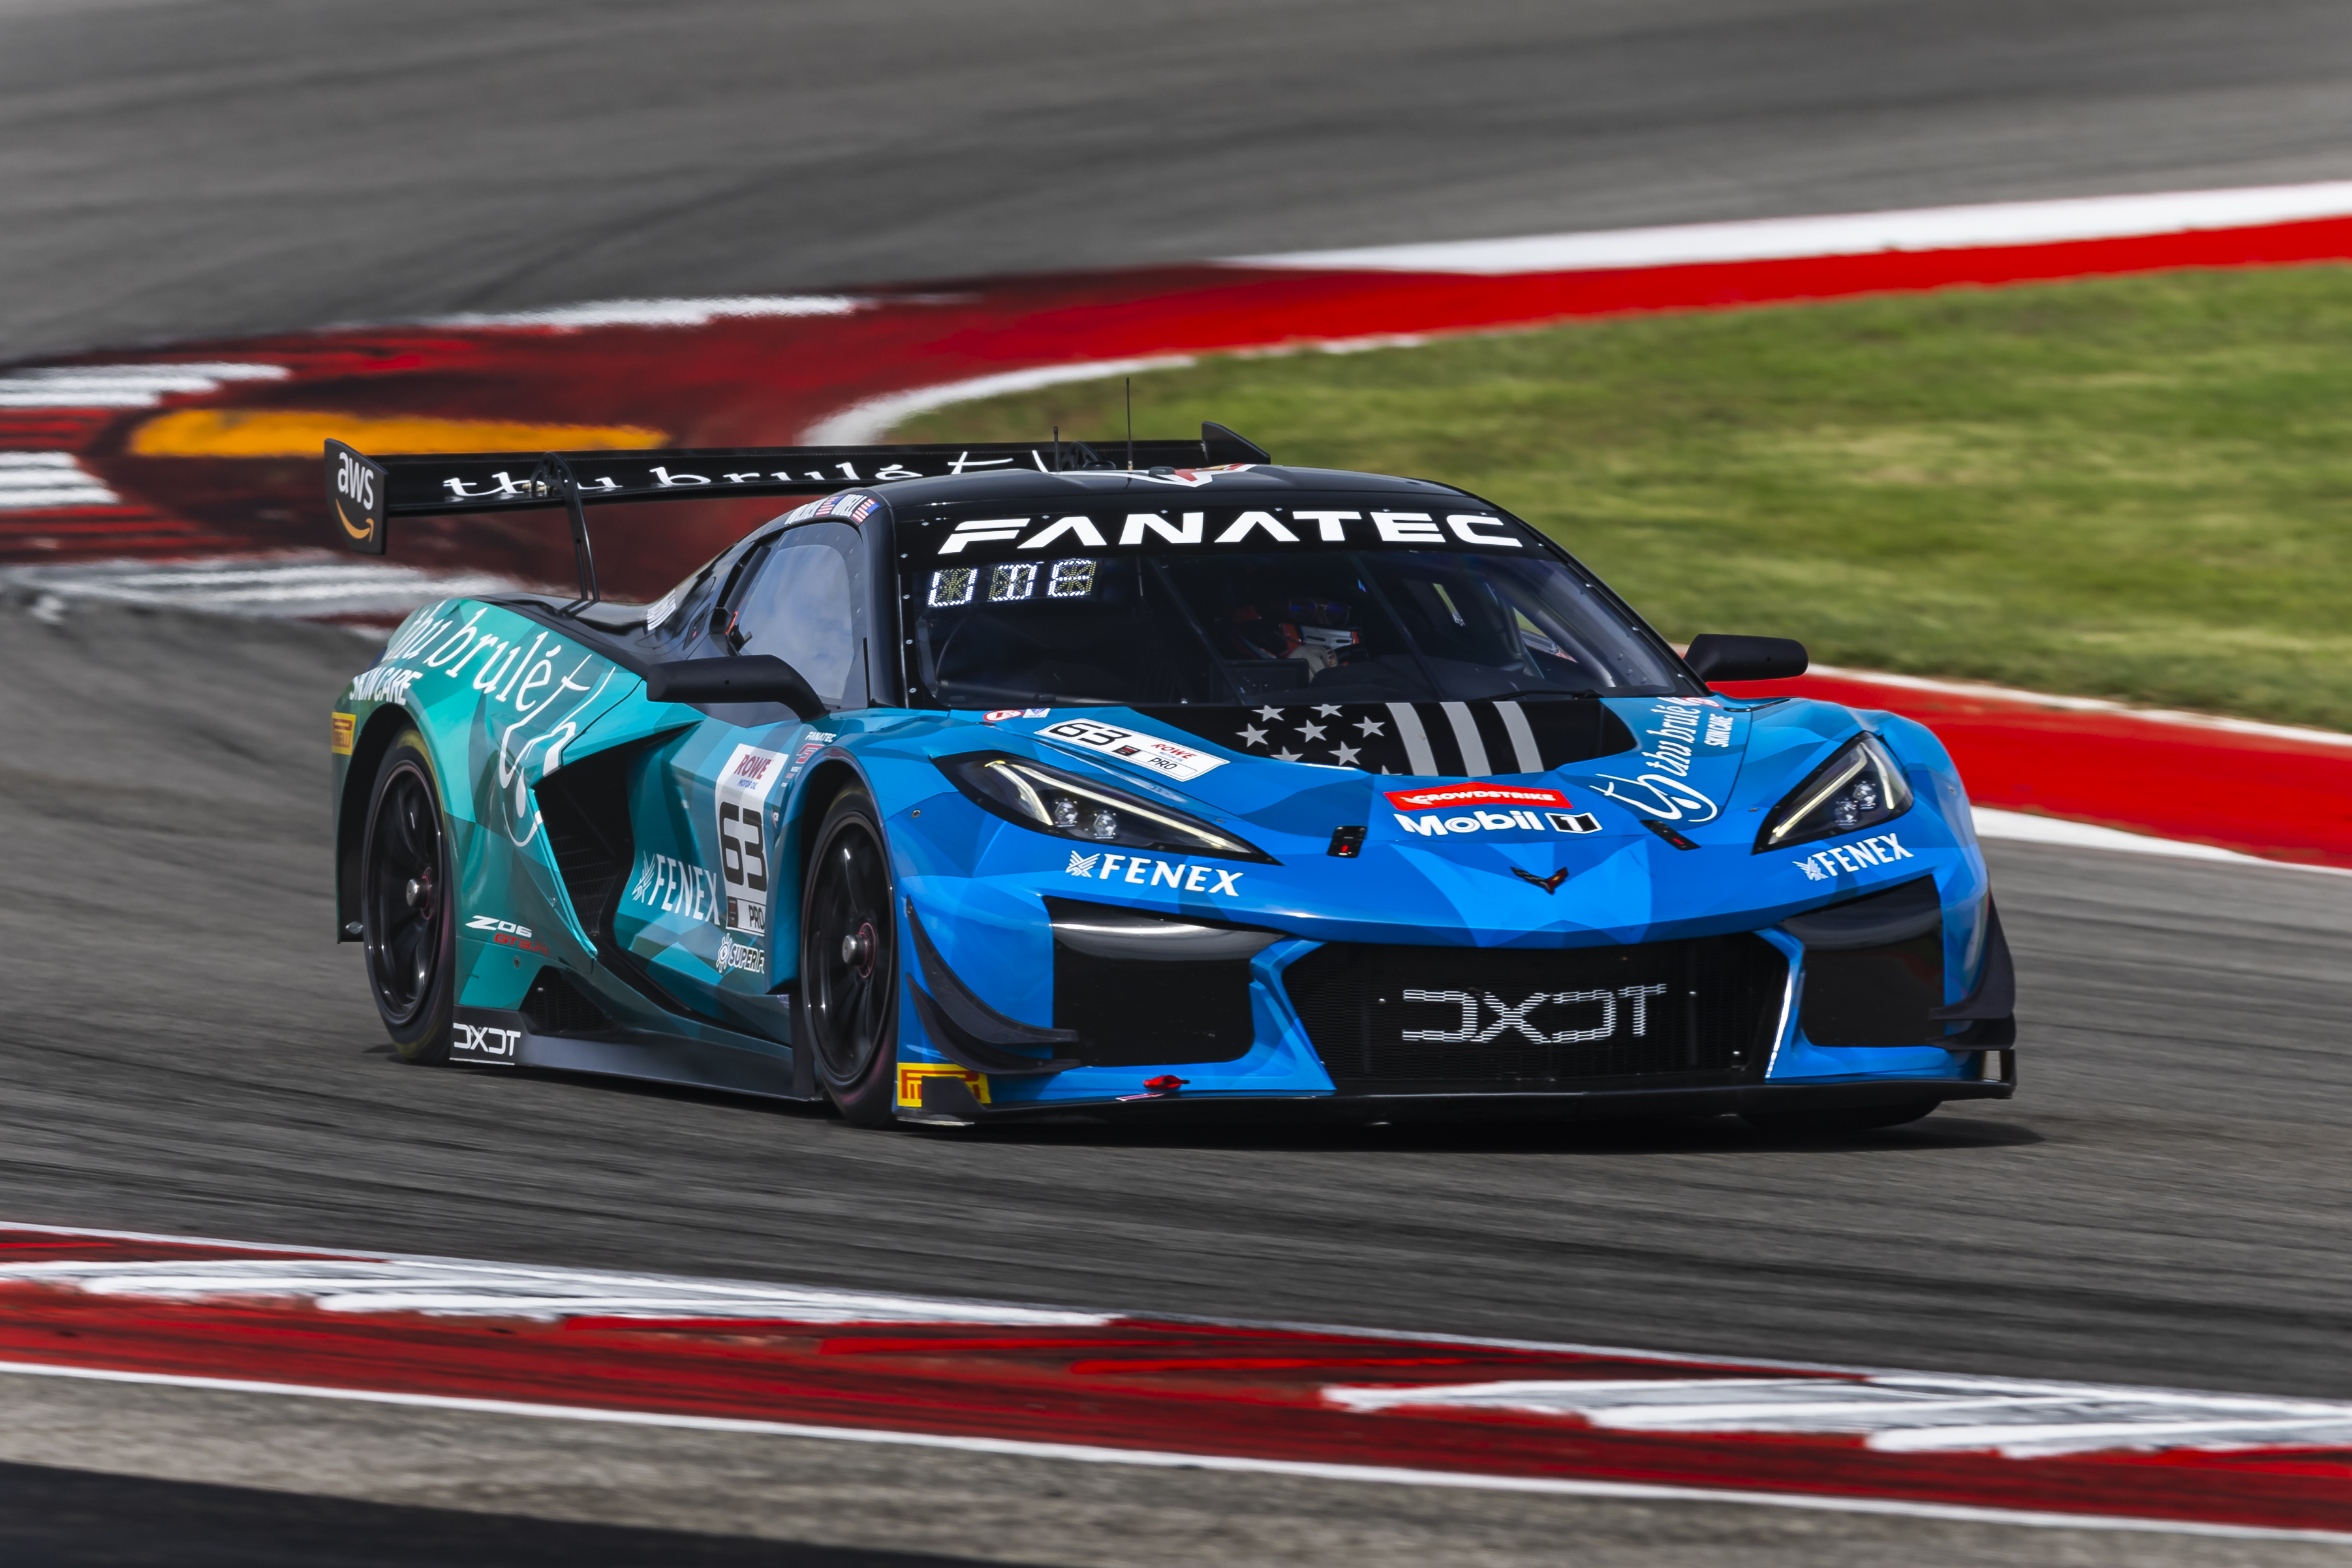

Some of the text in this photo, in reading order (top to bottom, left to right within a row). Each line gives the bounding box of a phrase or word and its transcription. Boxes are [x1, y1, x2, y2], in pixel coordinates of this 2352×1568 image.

[337, 452, 374, 510] aws
[938, 511, 1523, 555] FANATEC
[381, 600, 453, 663] thu
[423, 607, 561, 712] brulé
[374, 667, 424, 706] CARE
[805, 731, 837, 743] FANATEC
[1049, 722, 1132, 746] 63
[1641, 704, 1701, 776] thu brulé
[1704, 713, 1734, 748] SKIN CARE
[734, 754, 771, 780] ROWE
[1147, 757, 1177, 769] PRO
[1151, 743, 1198, 759] ROWE
[1414, 791, 1556, 801] CROWDSTRIKE
[1393, 810, 1545, 837] Mobil
[719, 801, 768, 892] 63
[1818, 833, 1914, 876] FENEX
[647, 853, 720, 925] FENEX
[1099, 853, 1244, 897] FENEX
[465, 915, 533, 938] Z06
[749, 904, 765, 930] PRO
[493, 932, 549, 957] GT3.R
[728, 943, 758, 972] SUPER
[1402, 983, 1667, 1044] DXDT
[453, 1022, 521, 1056] DXDT
